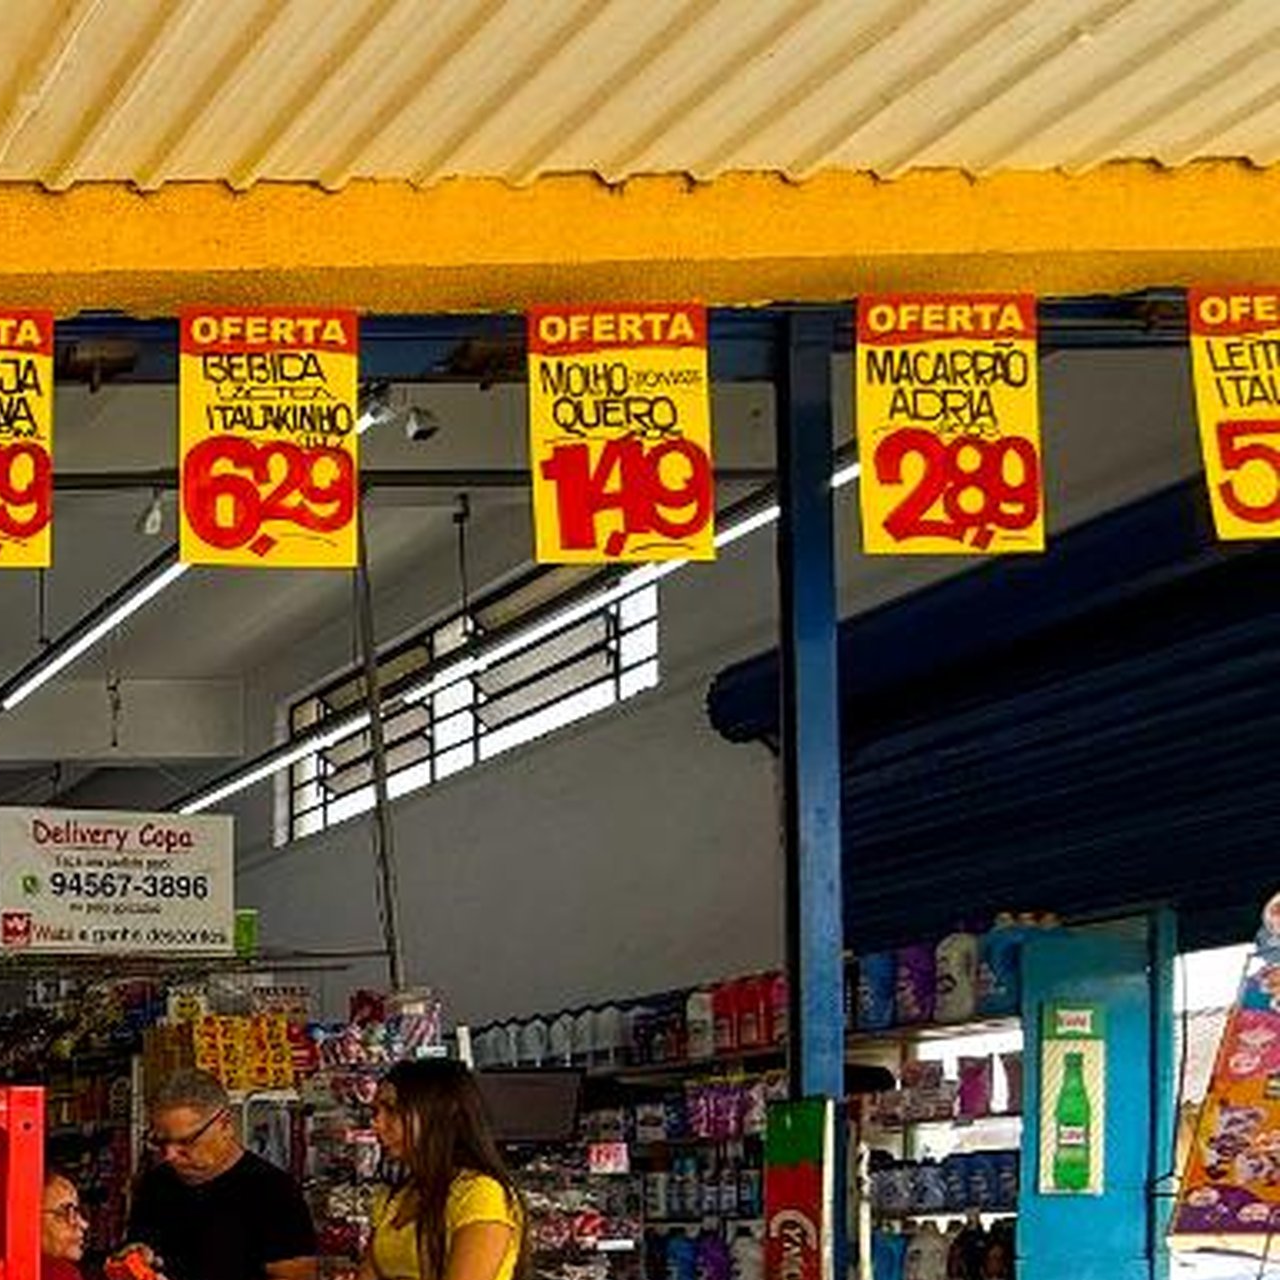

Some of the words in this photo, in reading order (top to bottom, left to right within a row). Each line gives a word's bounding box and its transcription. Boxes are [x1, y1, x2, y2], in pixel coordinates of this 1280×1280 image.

[868, 304, 1024, 332] OFERTA
[1200, 296, 1278, 325] OFE
[191, 315, 346, 346] OFERTA
[539, 312, 694, 343] OFERTA
[203, 353, 328, 383] BEBIDA
[866, 342, 1028, 388] MACARRÃO
[1206, 339, 1280, 372] LEIT
[541, 361, 628, 397] MOLHO
[1216, 374, 1280, 408] ITAL
[553, 396, 678, 437] QUERO
[889, 388, 998, 427] ADRIA
[33, 820, 130, 851] Delivery
[139, 824, 195, 852] Copa
[50, 873, 209, 899] 94567-3896
